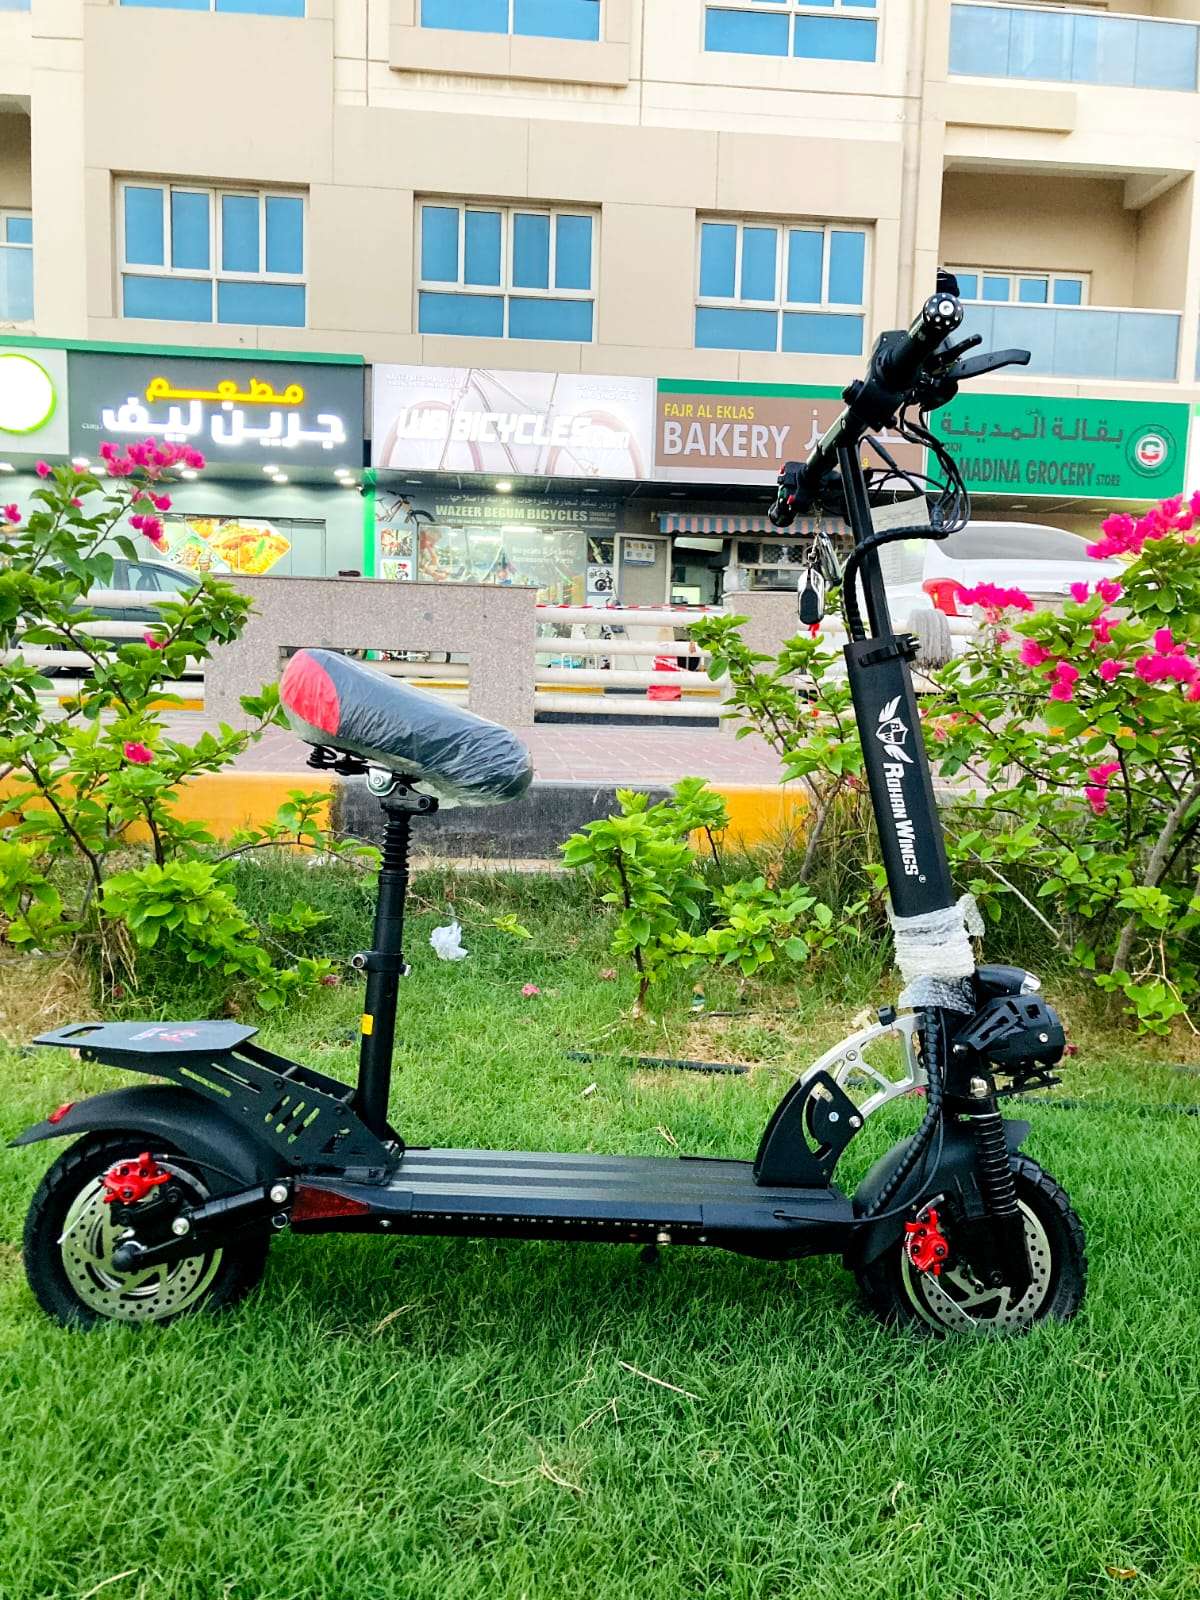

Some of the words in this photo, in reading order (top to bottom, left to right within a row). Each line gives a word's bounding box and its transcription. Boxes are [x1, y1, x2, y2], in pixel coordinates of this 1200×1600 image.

[145, 377, 305, 404] مطعم
[102, 396, 203, 443] ليف
[211, 401, 347, 449] جرين
[664, 403, 693, 417] FAJR
[697, 404, 712, 418] AL
[717, 405, 755, 420] EKLAS
[663, 421, 791, 459] BAKERY
[940, 412, 1047, 443] المدينة
[1052, 416, 1124, 449] بقالة
[959, 457, 1021, 483] MADINA
[1025, 460, 1096, 487] GROCERY
[435, 504, 482, 517] WAZEER
[484, 506, 525, 519] BEGUM
[526, 508, 588, 521] BICYCLES
